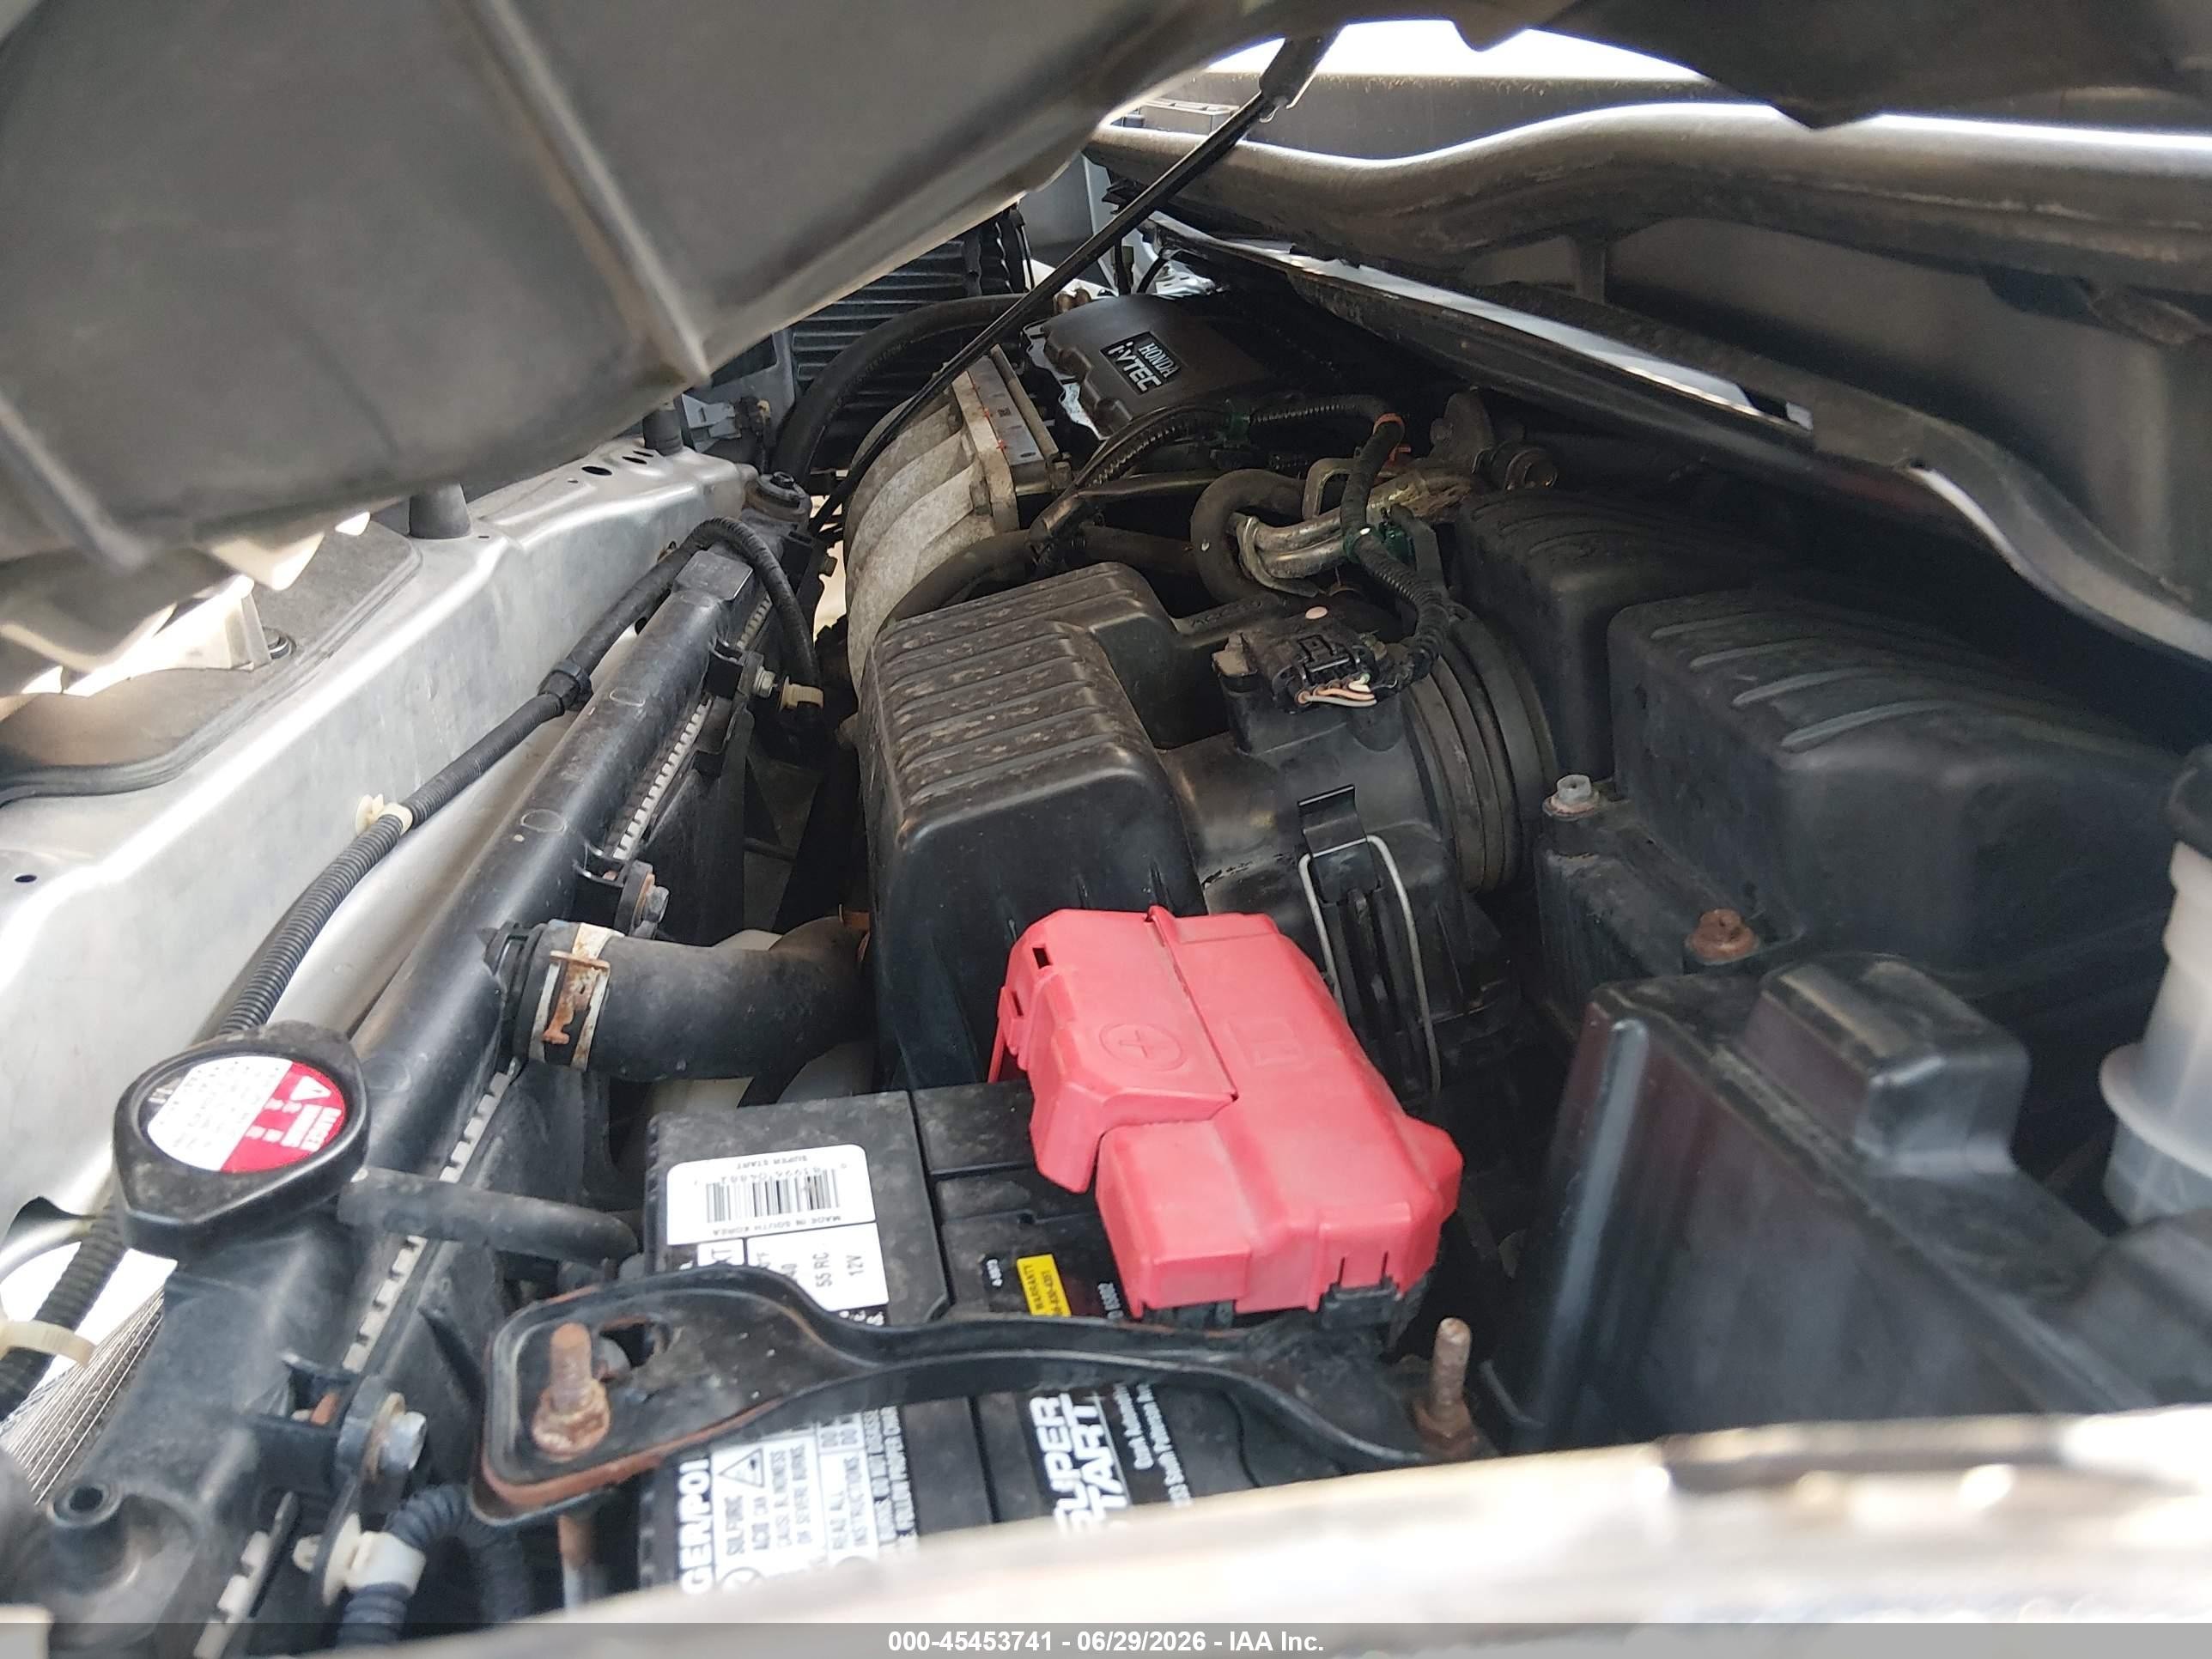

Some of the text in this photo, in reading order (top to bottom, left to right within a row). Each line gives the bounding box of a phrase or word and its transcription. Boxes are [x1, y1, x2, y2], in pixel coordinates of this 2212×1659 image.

[1138, 341, 1181, 379] HONDA
[773, 1155, 806, 1164] SUPER
[753, 1220, 790, 1231] SOUTH
[811, 1215, 841, 1224] MADE
[812, 1251, 830, 1269] RC
[847, 1254, 863, 1275] 12V
